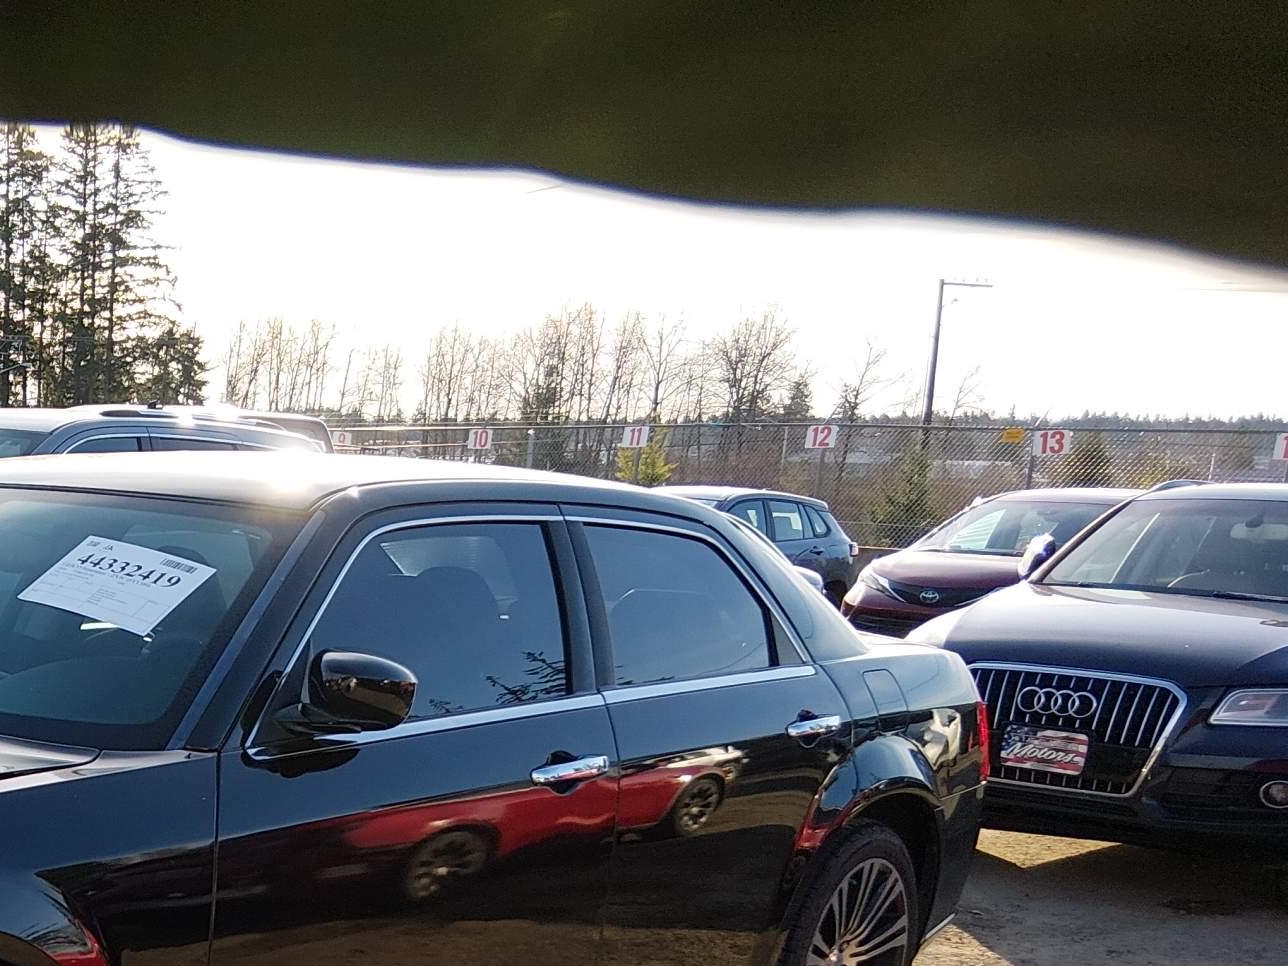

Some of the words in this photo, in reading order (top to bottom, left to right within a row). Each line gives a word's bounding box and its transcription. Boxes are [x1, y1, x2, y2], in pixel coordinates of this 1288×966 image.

[472, 430, 489, 448] 10
[628, 428, 643, 446] 11
[810, 426, 833, 448] 12
[1039, 430, 1065, 454] 13
[76, 553, 182, 588] 44332419
[1005, 742, 1076, 763] Motors
